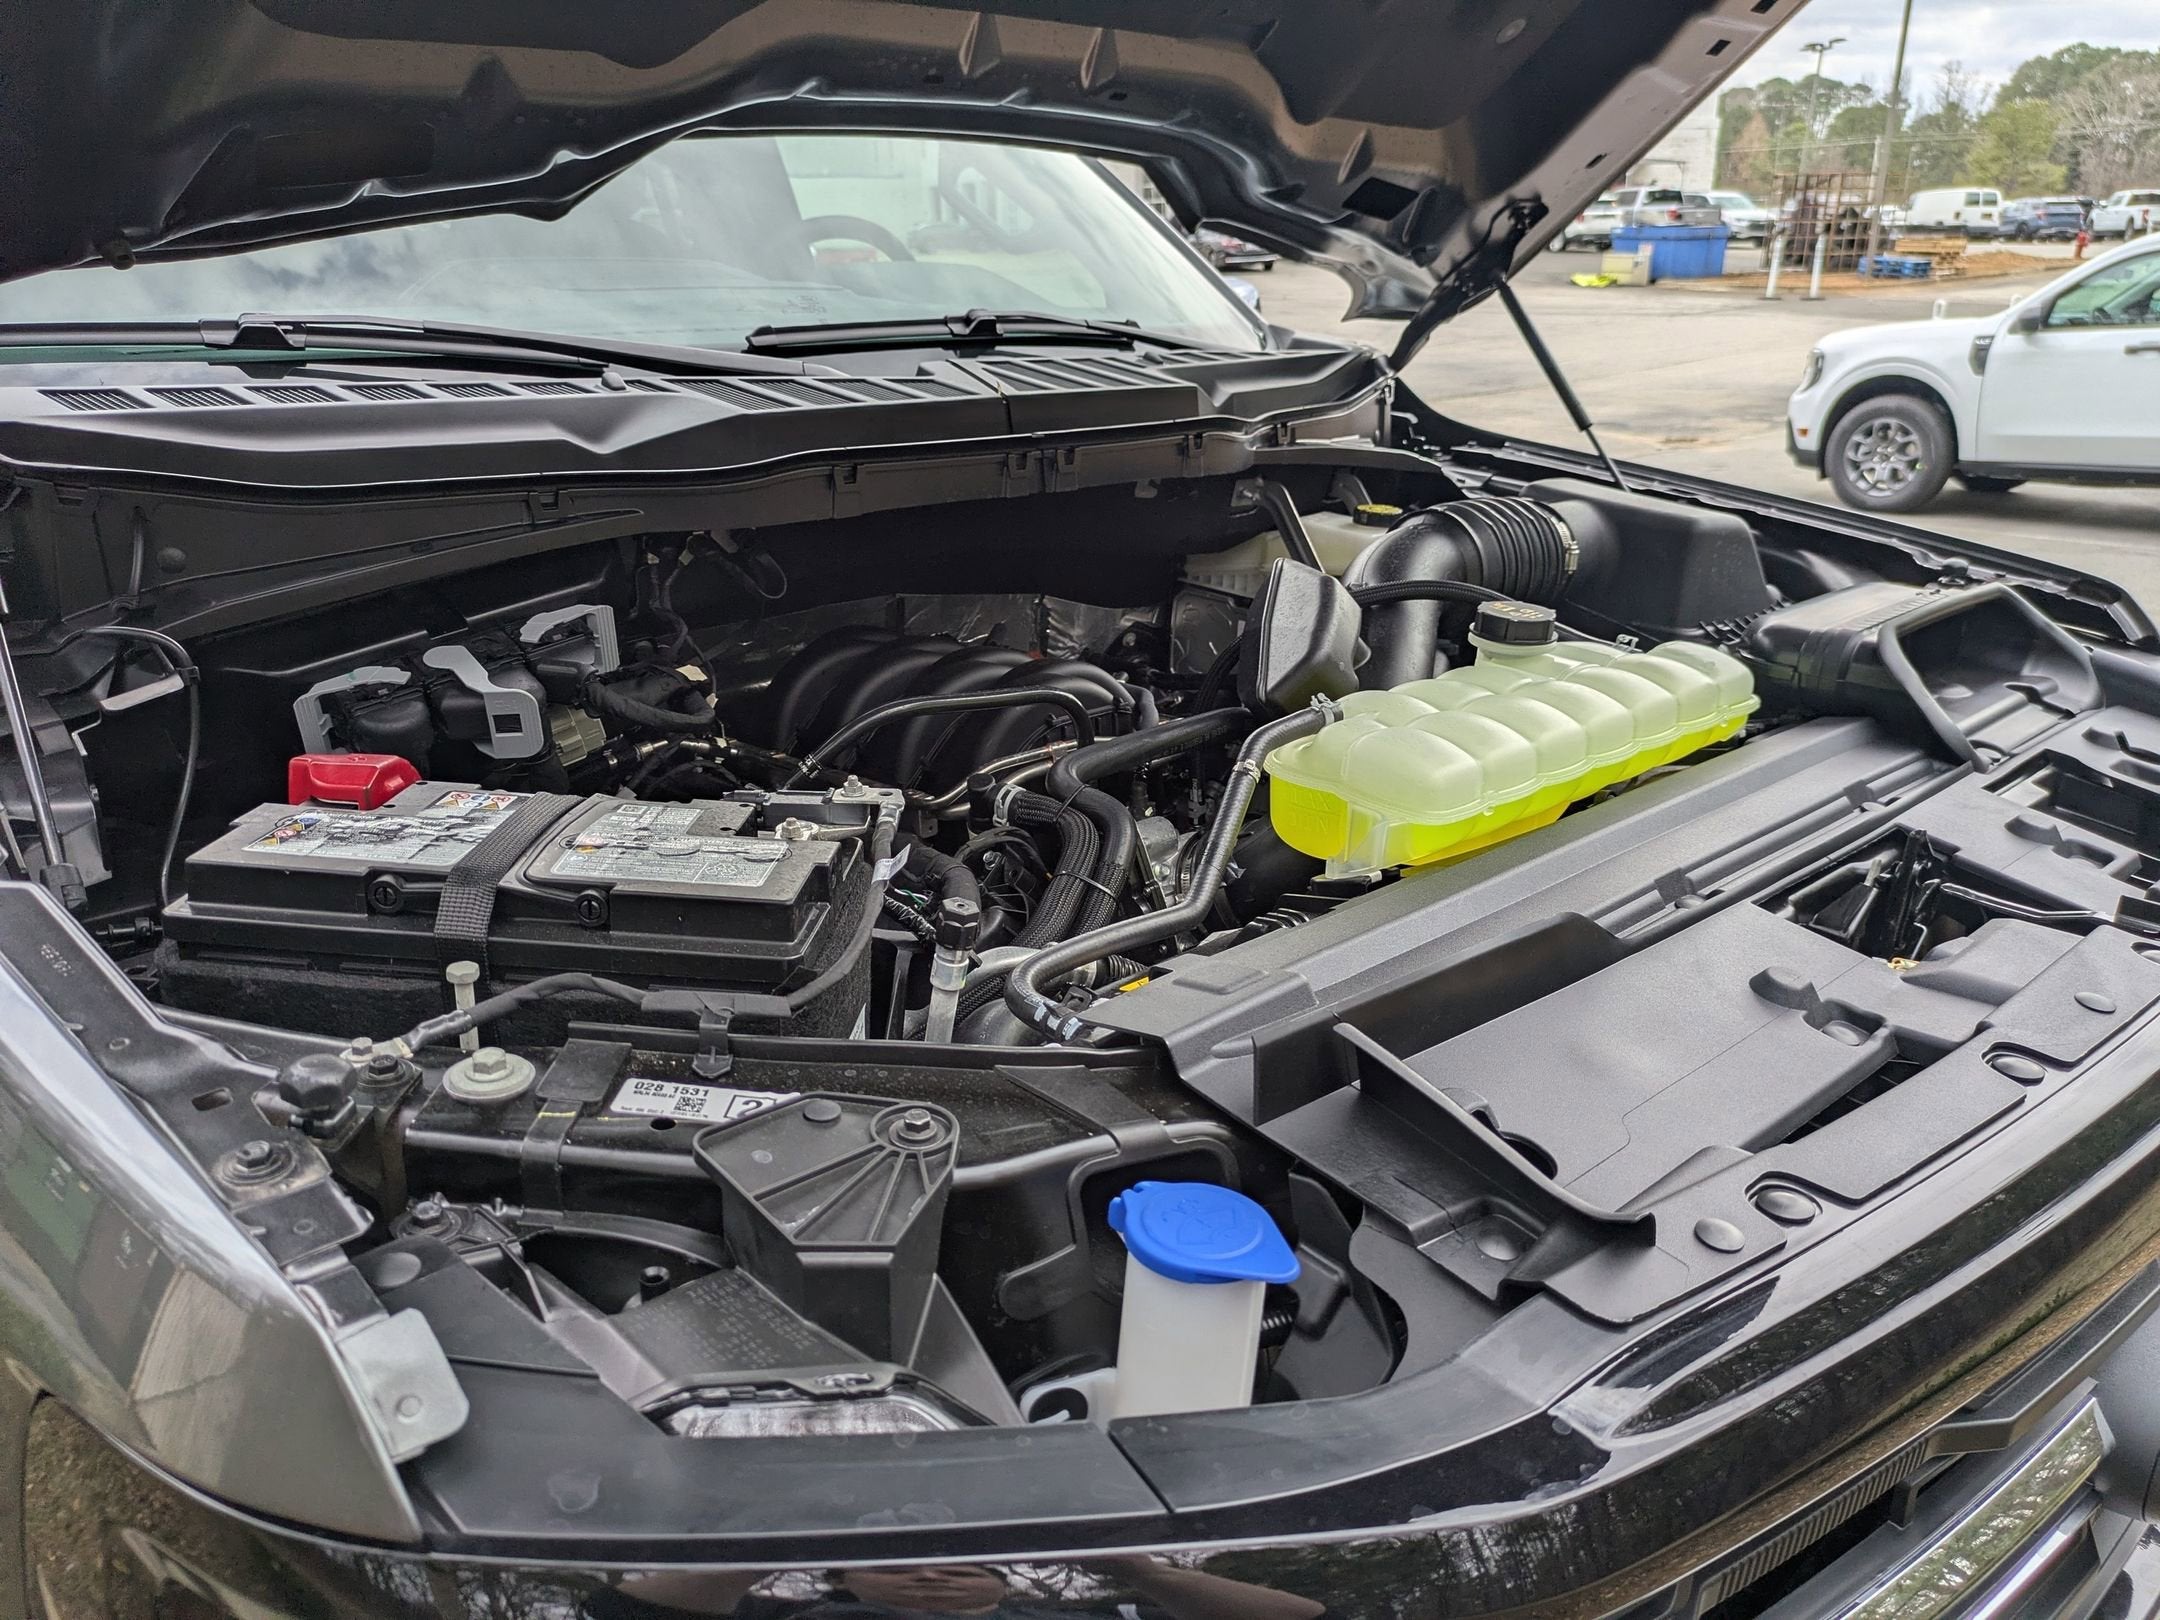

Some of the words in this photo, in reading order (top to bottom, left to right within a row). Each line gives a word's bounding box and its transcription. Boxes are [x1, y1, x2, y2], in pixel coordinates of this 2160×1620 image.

[634, 1081, 665, 1092] 028
[673, 1086, 710, 1097] 1531
[737, 1099, 763, 1118] 2
